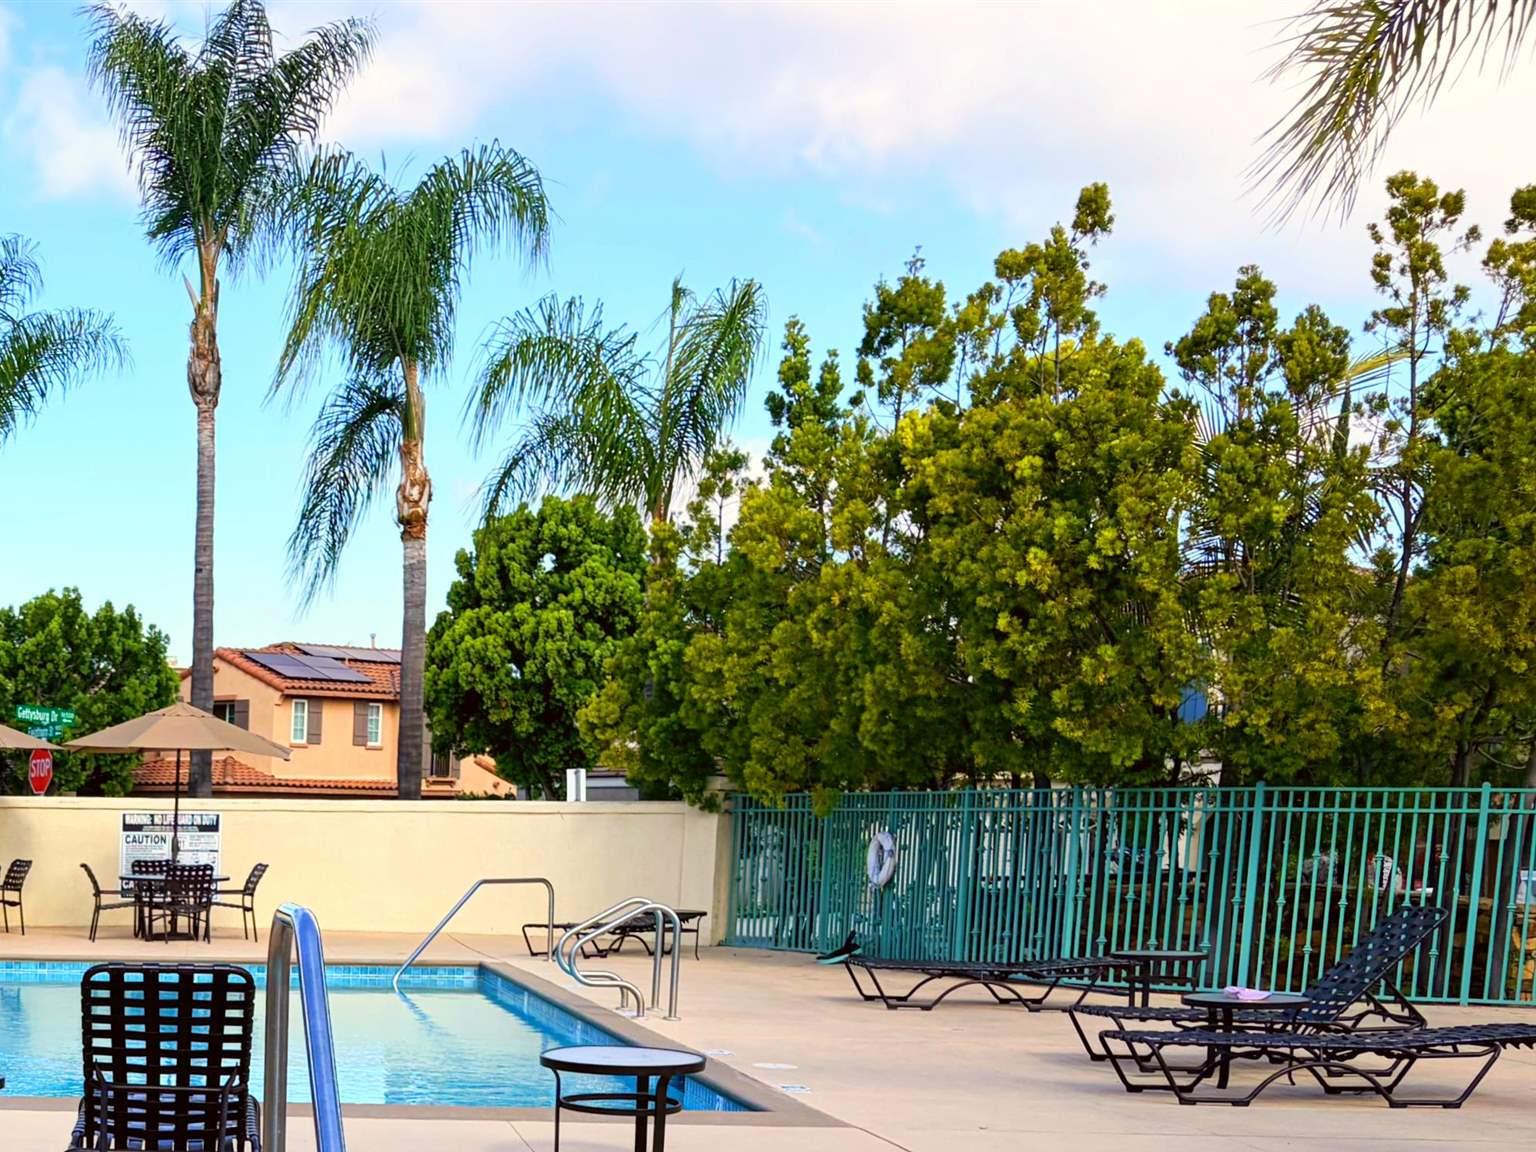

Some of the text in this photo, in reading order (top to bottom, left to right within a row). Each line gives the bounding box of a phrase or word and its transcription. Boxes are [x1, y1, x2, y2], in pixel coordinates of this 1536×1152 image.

[17, 706, 50, 725] Gettysburg
[51, 710, 58, 722] Dr
[31, 758, 51, 777] STOP
[125, 834, 167, 845] CAUTION
